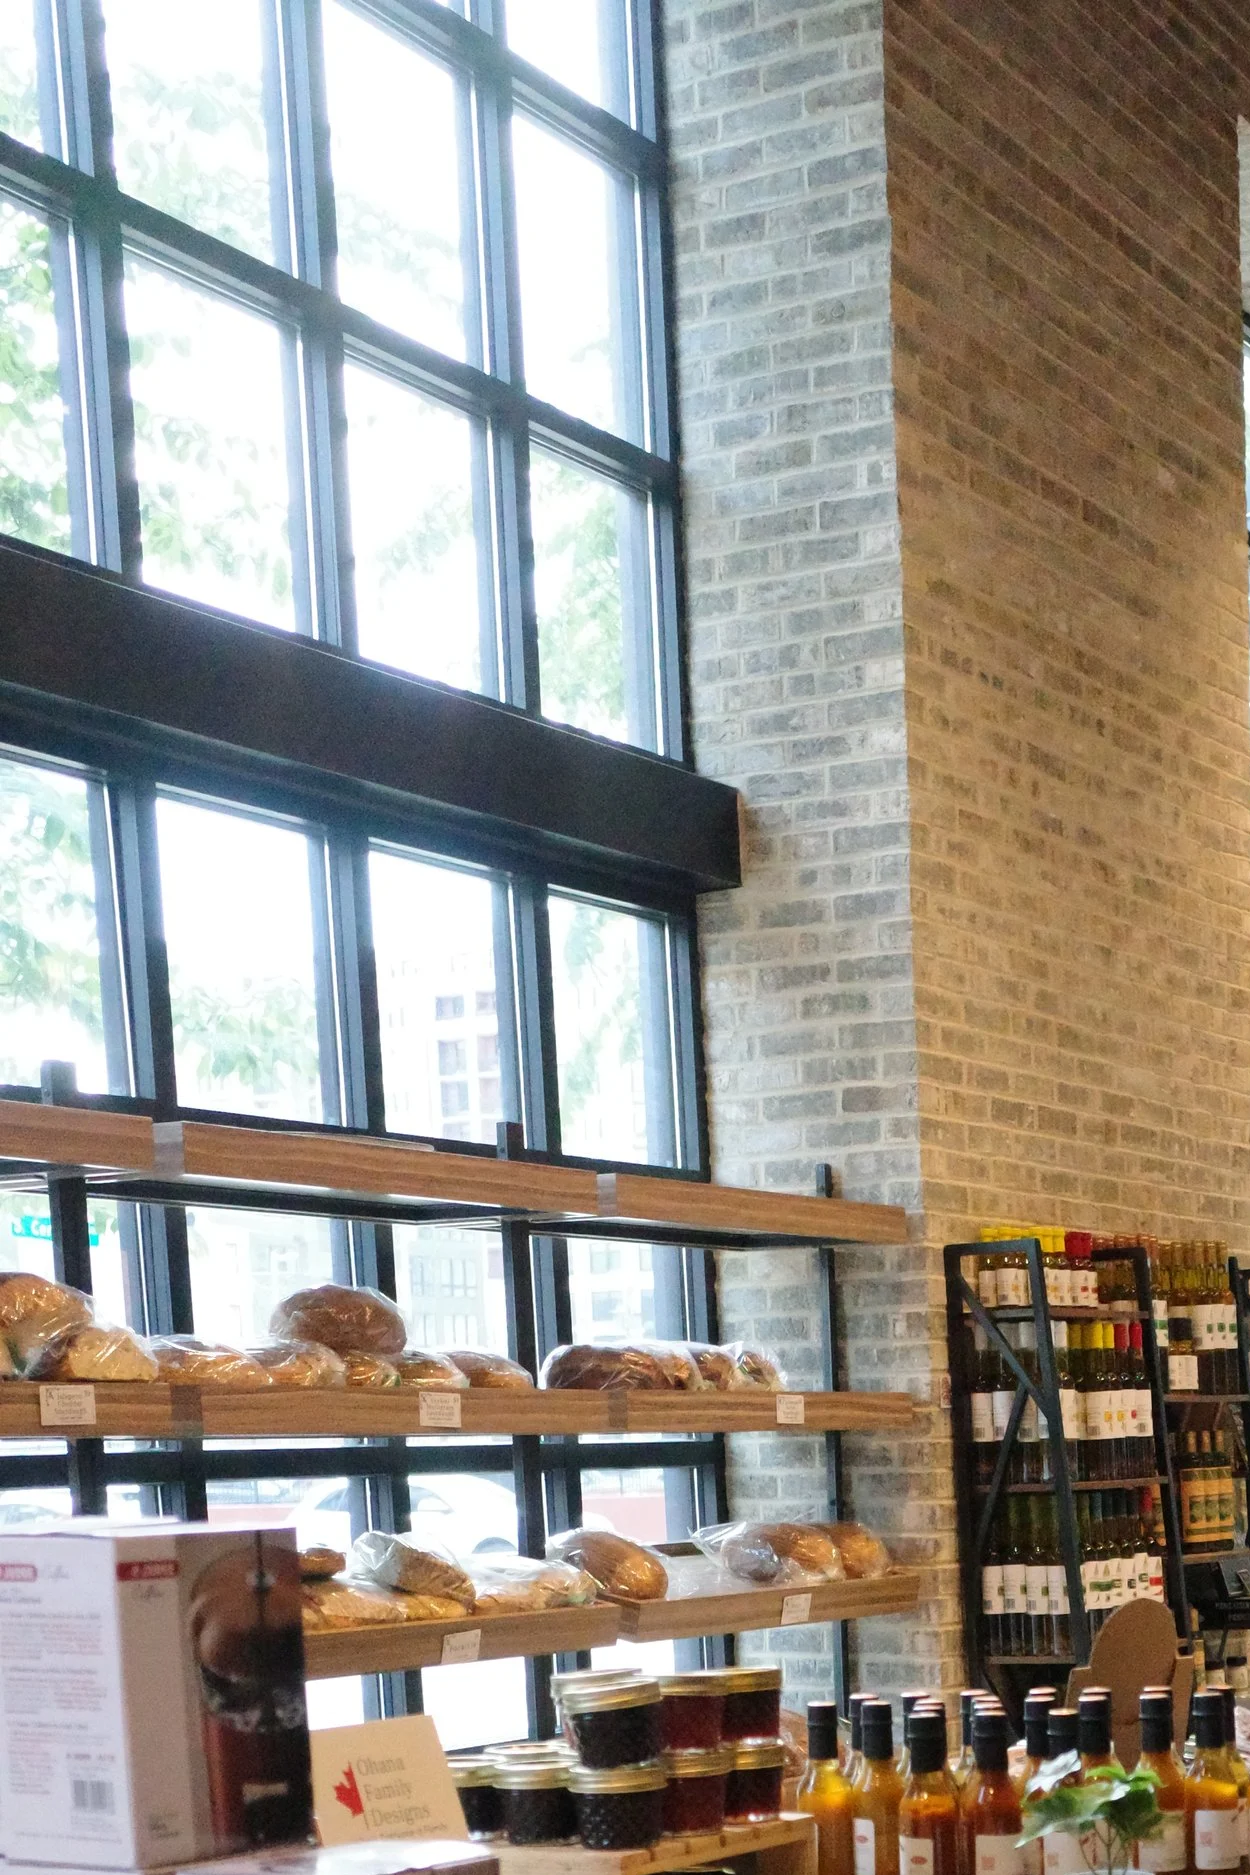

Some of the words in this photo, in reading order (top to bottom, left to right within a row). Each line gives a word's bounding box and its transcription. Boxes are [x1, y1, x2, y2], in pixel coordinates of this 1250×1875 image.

[357, 1757, 405, 1776] Ohana
[363, 1779, 412, 1802] Family
[371, 1803, 430, 1828] Designs
